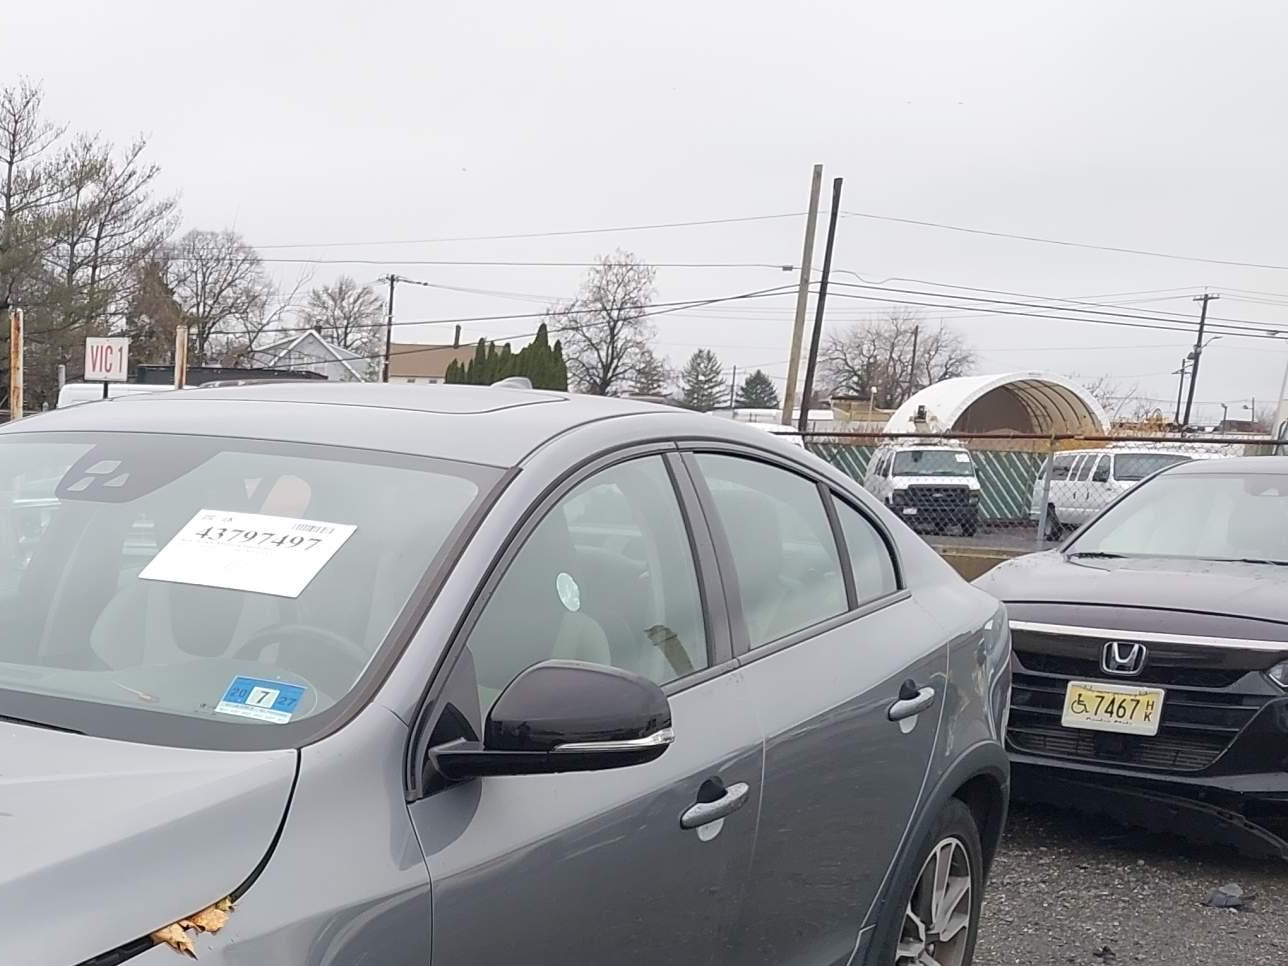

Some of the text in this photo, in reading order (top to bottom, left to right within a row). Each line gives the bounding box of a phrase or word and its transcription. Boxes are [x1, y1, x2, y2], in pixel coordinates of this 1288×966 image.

[90, 344, 123, 373] VIC 1
[195, 526, 323, 551] 43797497
[256, 690, 270, 704] 7
[1094, 695, 1141, 720] 7467
